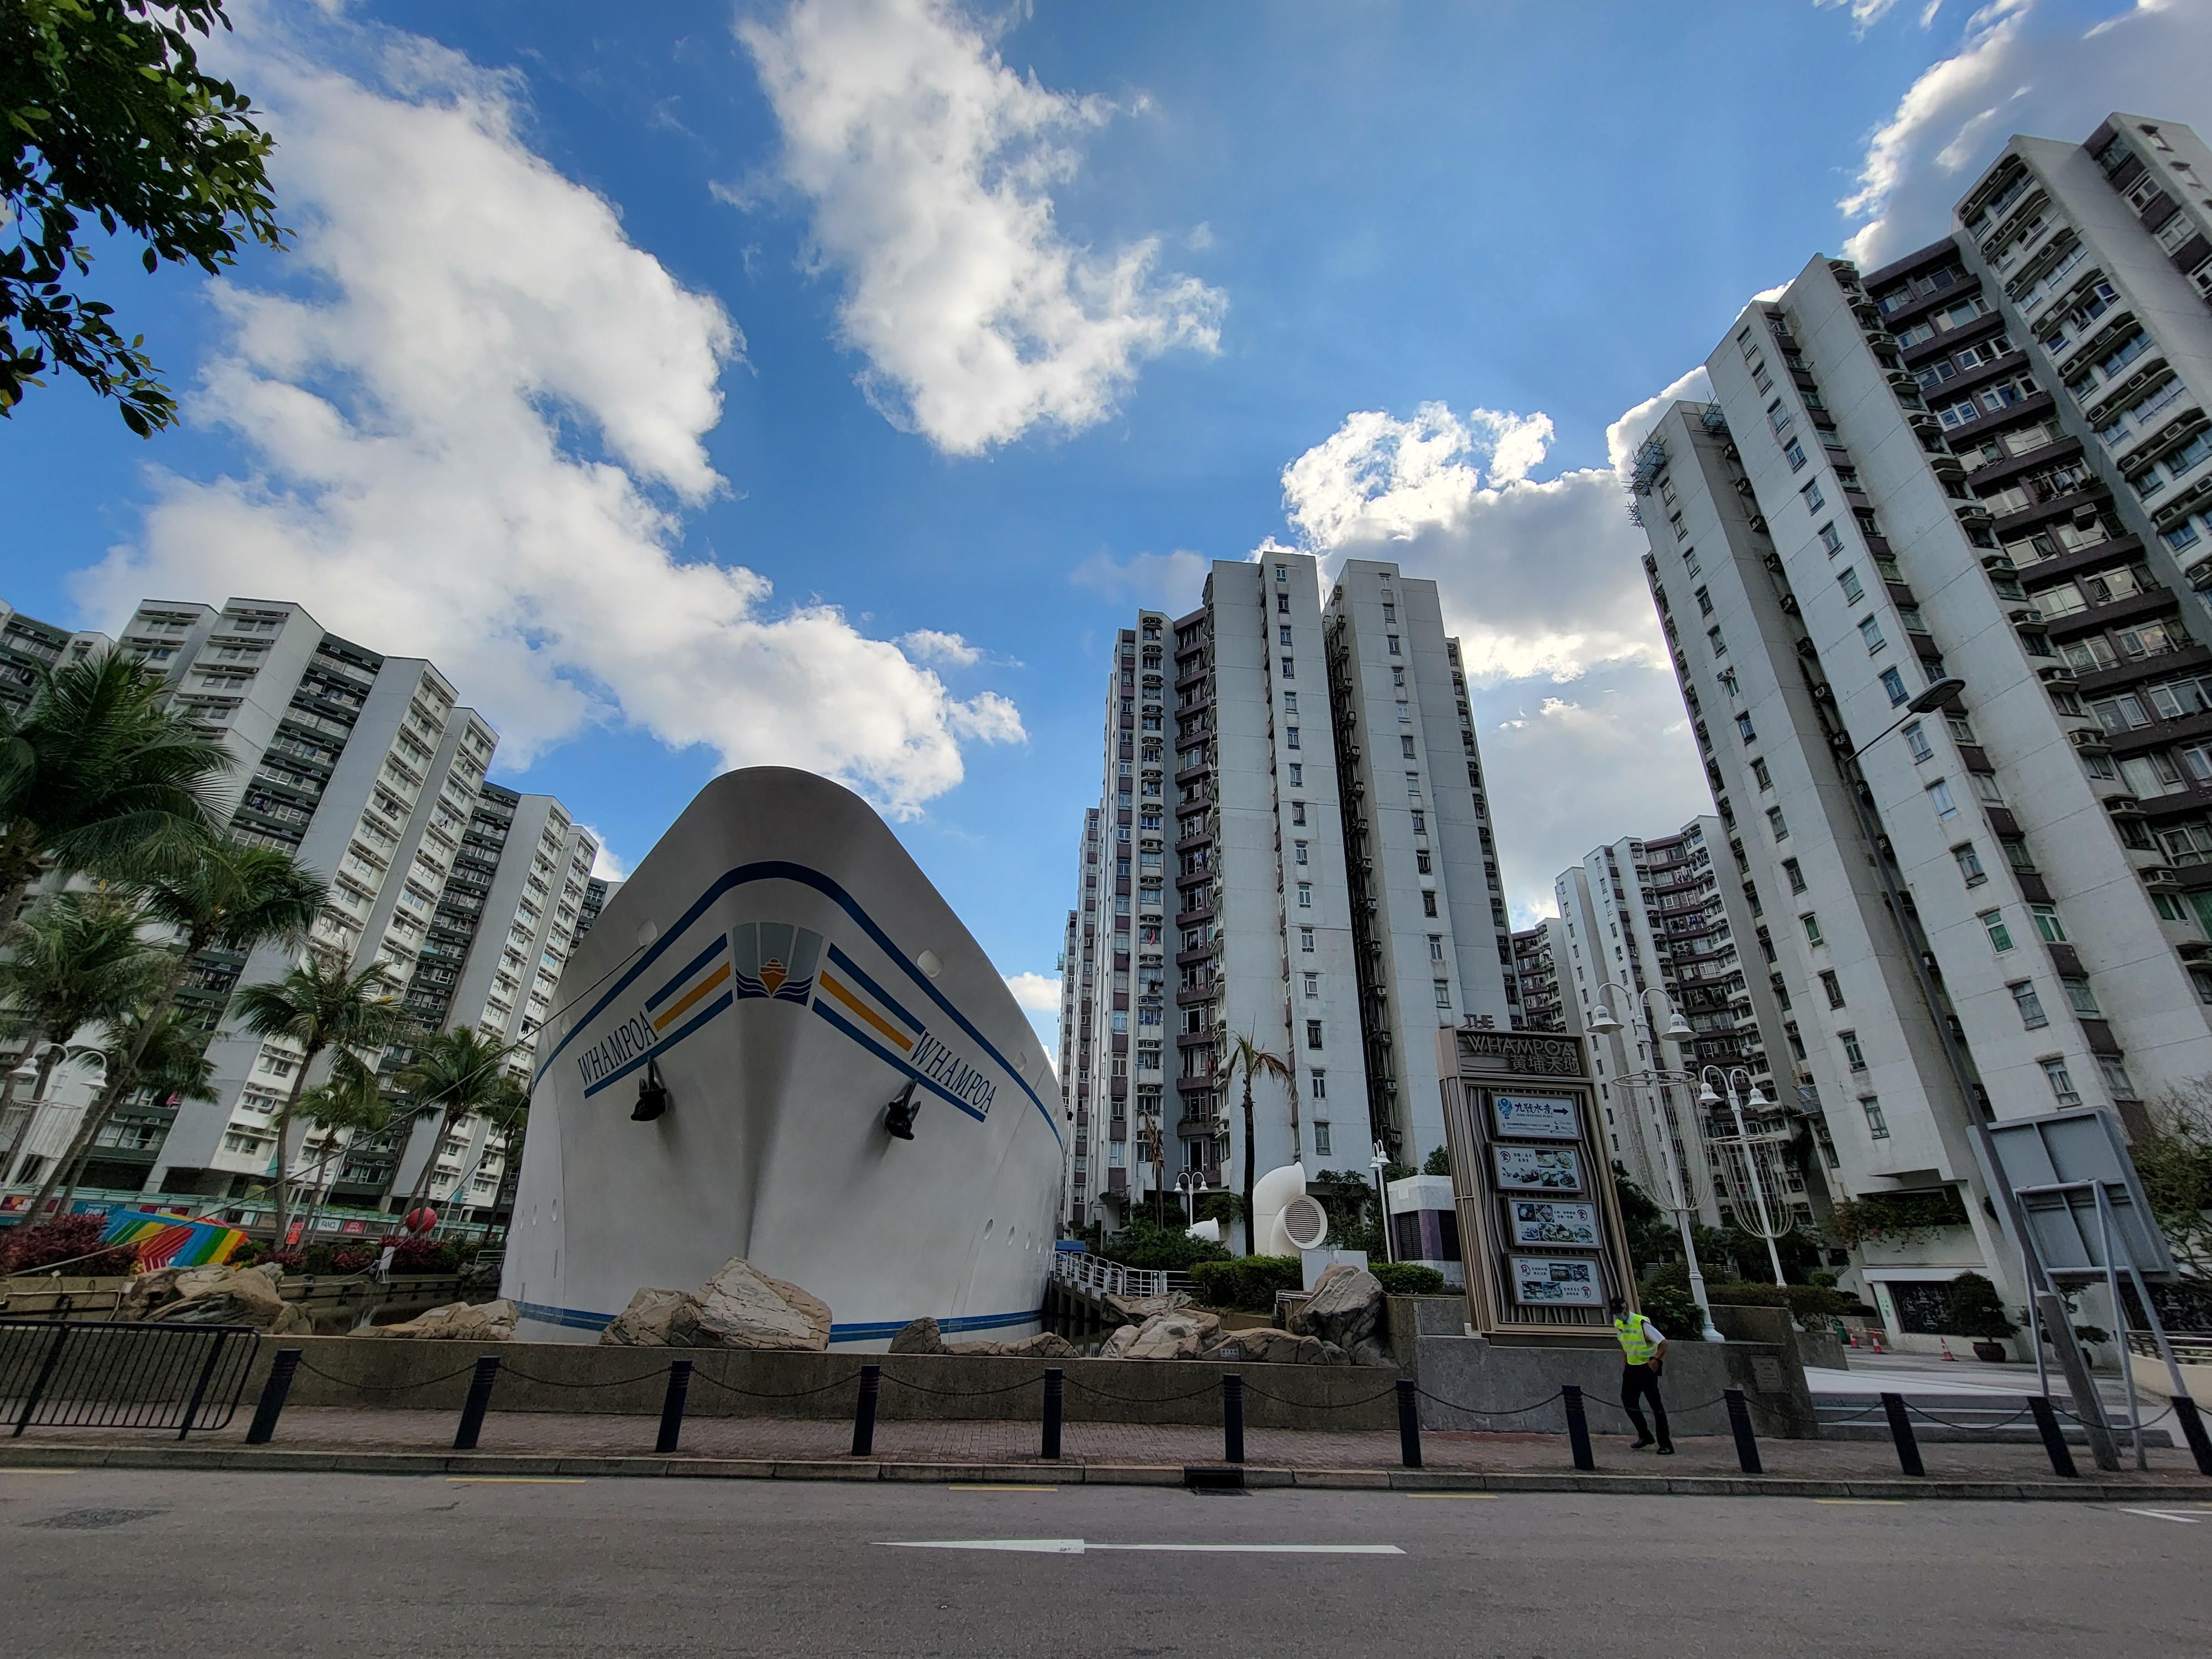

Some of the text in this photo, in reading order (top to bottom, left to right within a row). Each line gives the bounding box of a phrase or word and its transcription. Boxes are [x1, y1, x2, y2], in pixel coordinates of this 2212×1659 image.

[1463, 1014, 1495, 1029] THE
[577, 1010, 659, 1086] WHAMPOA
[1466, 1035, 1577, 1057] WHAMPOA
[910, 1031, 997, 1114] WHAMPOA
[1510, 1053, 1579, 1073] 黃埔天地
